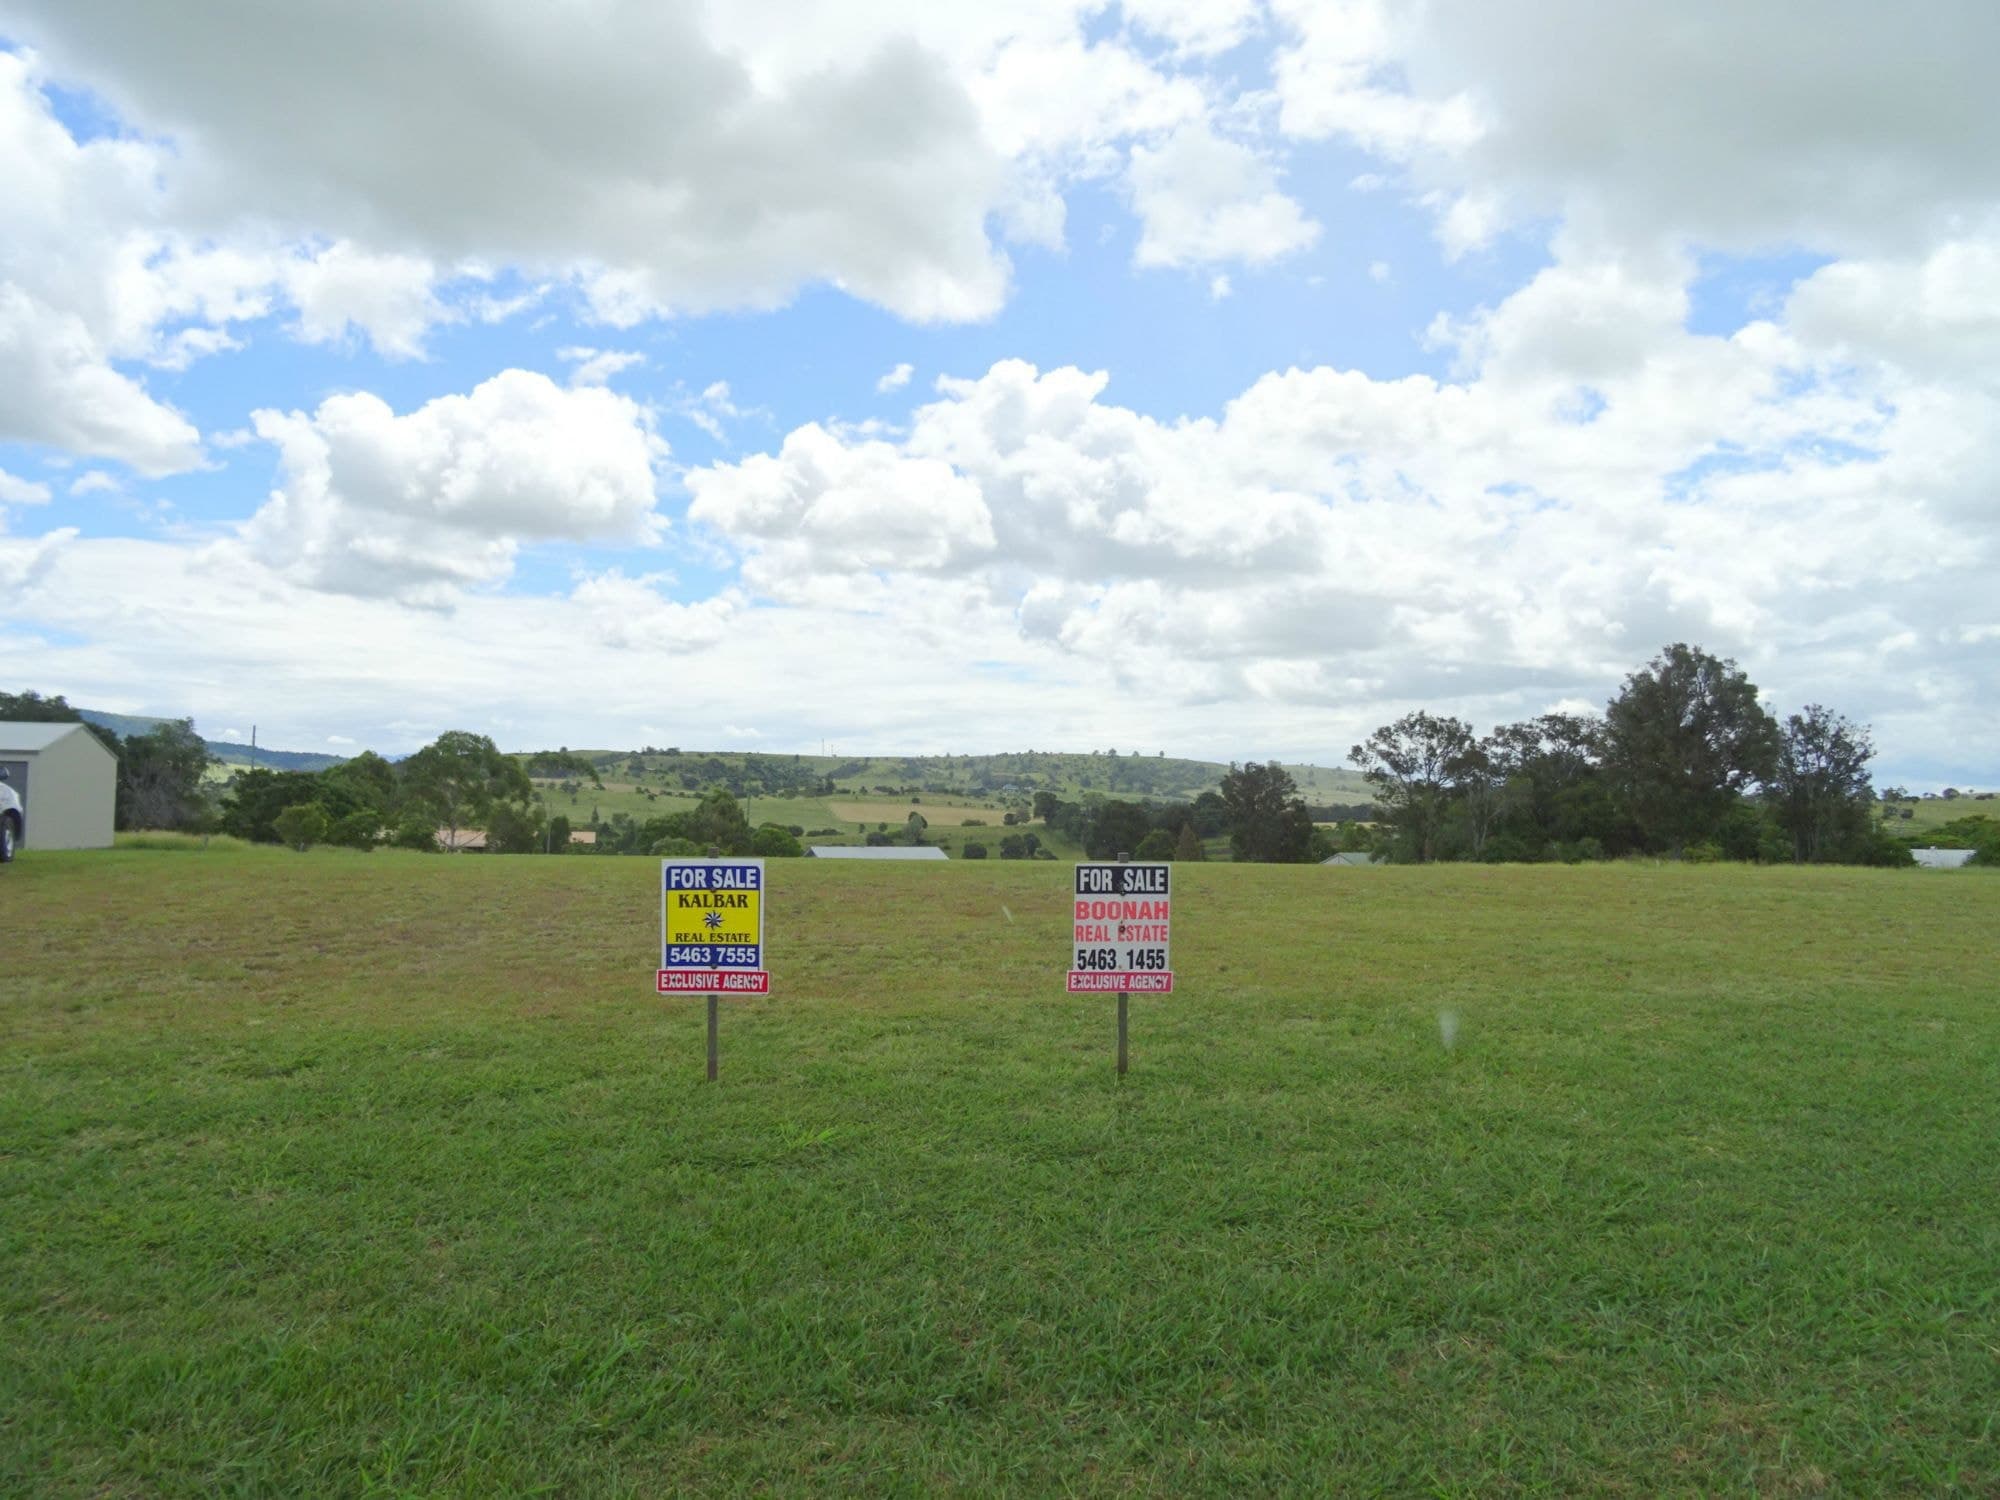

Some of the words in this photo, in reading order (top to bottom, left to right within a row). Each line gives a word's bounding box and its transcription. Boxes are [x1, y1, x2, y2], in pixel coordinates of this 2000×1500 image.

[670, 868, 706, 888] FOR
[712, 868, 757, 888] SALE
[1079, 868, 1113, 891] FOR
[1123, 868, 1165, 891] SALE
[678, 894, 748, 908] KALBAR
[1075, 901, 1169, 920] BOONAH
[675, 933, 705, 942] REAL
[709, 933, 751, 942] ESTATE
[1075, 925, 1111, 942] REAL
[1117, 925, 1168, 942] ESTATE
[670, 947, 711, 963] 5463
[716, 947, 756, 963] 7555
[1077, 949, 1117, 970] 5463
[1126, 949, 1165, 970] 1455
[661, 973, 719, 988] EXCLUSIVE
[723, 974, 764, 990] AGENCY
[1070, 975, 1126, 989] EXCLUSIVE
[1128, 975, 1168, 990] AGENCY
